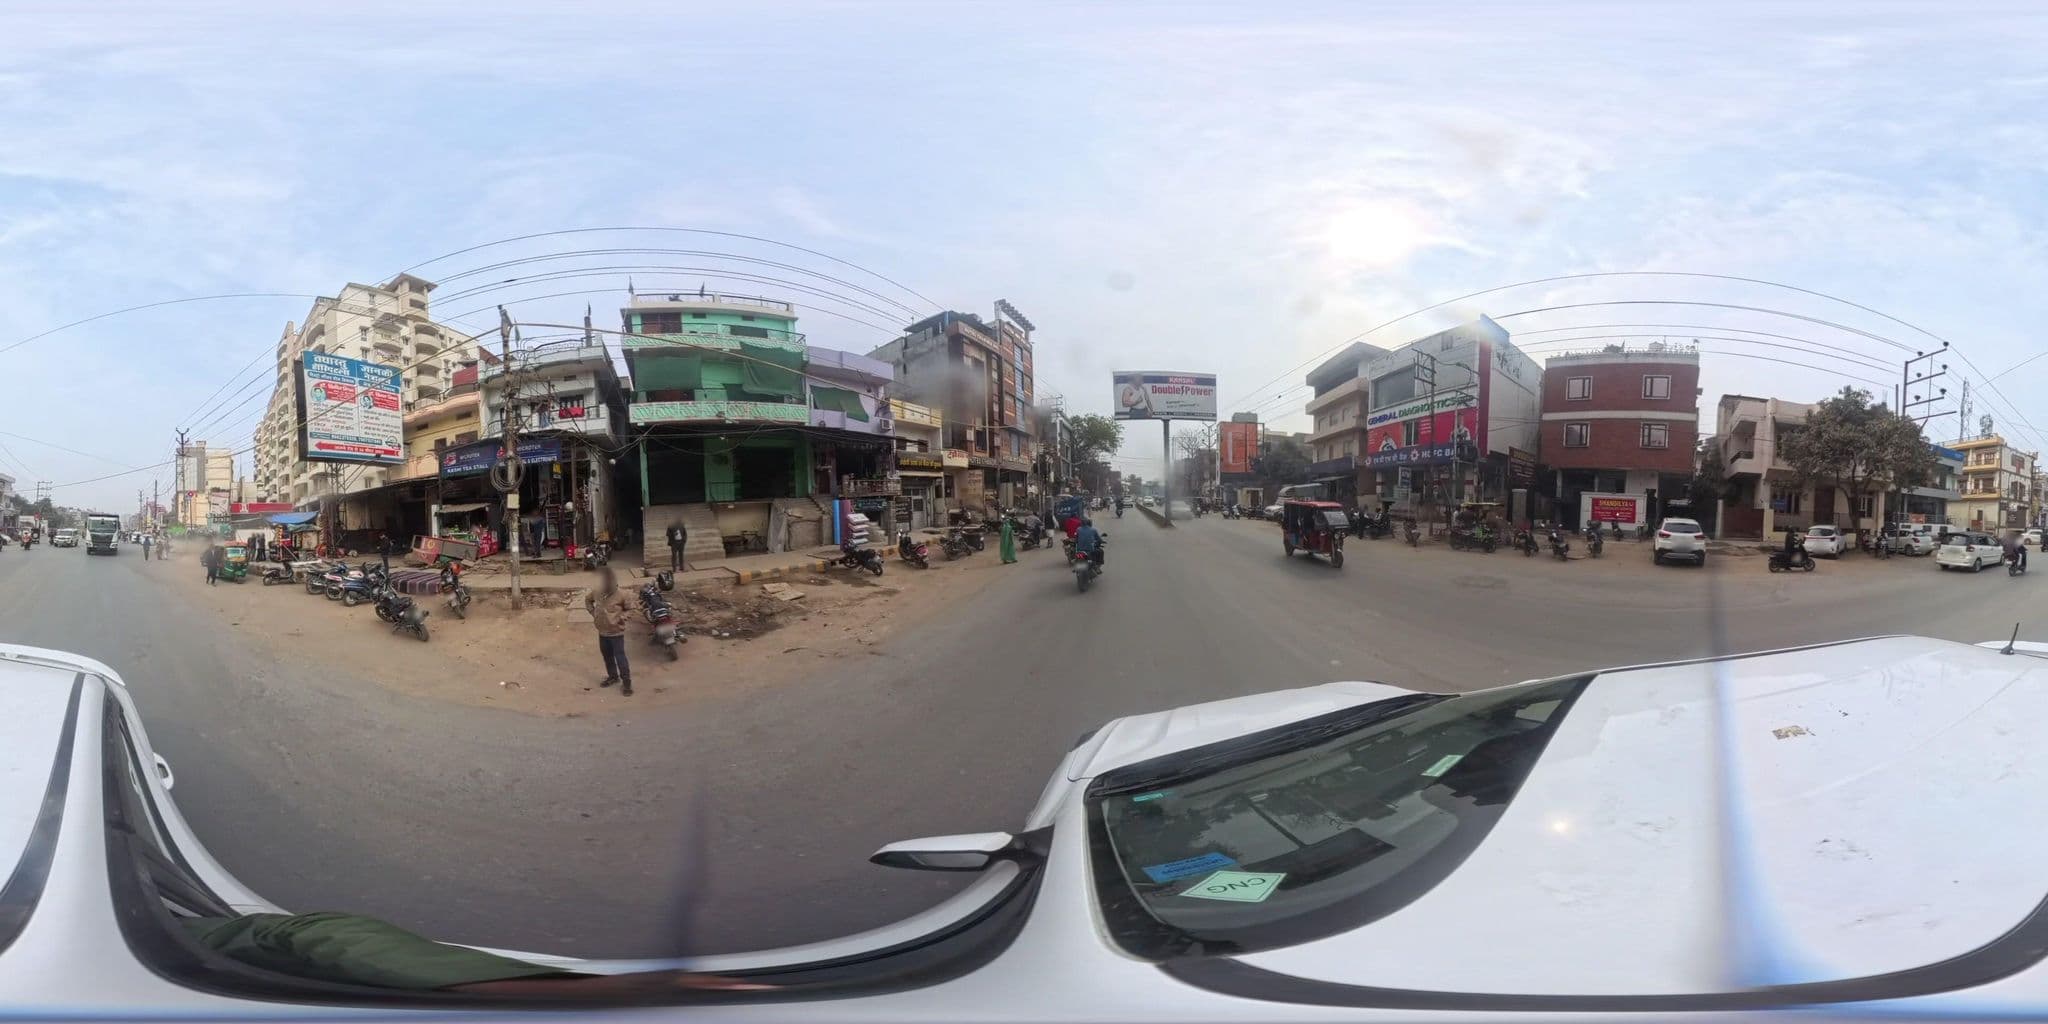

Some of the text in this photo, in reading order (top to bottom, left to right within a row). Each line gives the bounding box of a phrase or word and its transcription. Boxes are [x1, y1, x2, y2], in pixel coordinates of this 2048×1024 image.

[1151, 385, 1214, 396] Double Power
[1398, 397, 1457, 418] DIAGNOTICS
[1206, 877, 1266, 893] CNG
